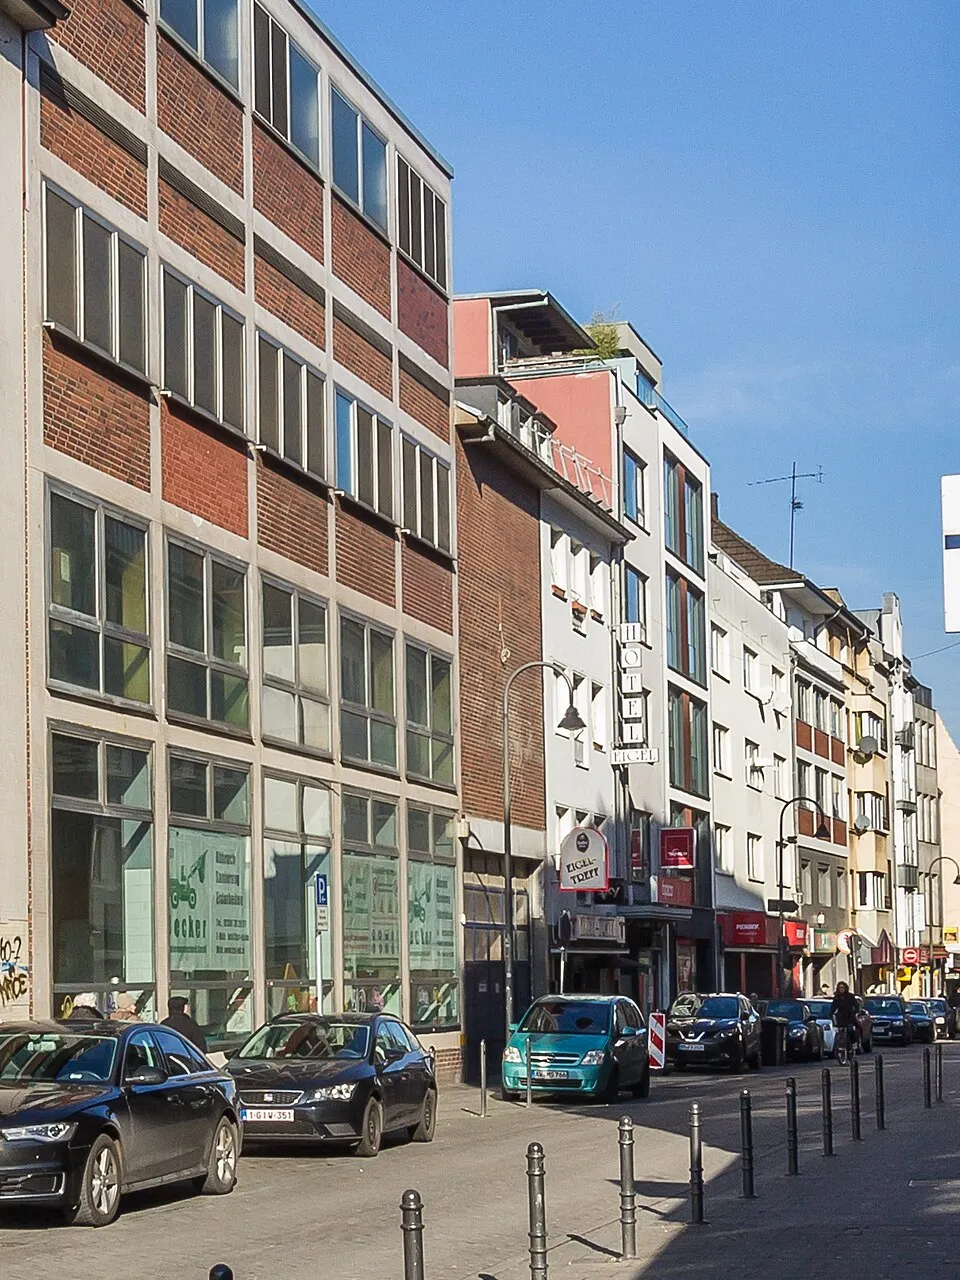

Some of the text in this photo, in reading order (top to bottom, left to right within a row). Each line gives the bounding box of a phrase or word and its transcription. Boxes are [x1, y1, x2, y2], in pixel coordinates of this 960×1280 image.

[624, 624, 639, 741] HOTEL
[613, 750, 656, 763] EIGEL
[570, 867, 599, 885] TREFF
[170, 915, 206, 939] ecker
